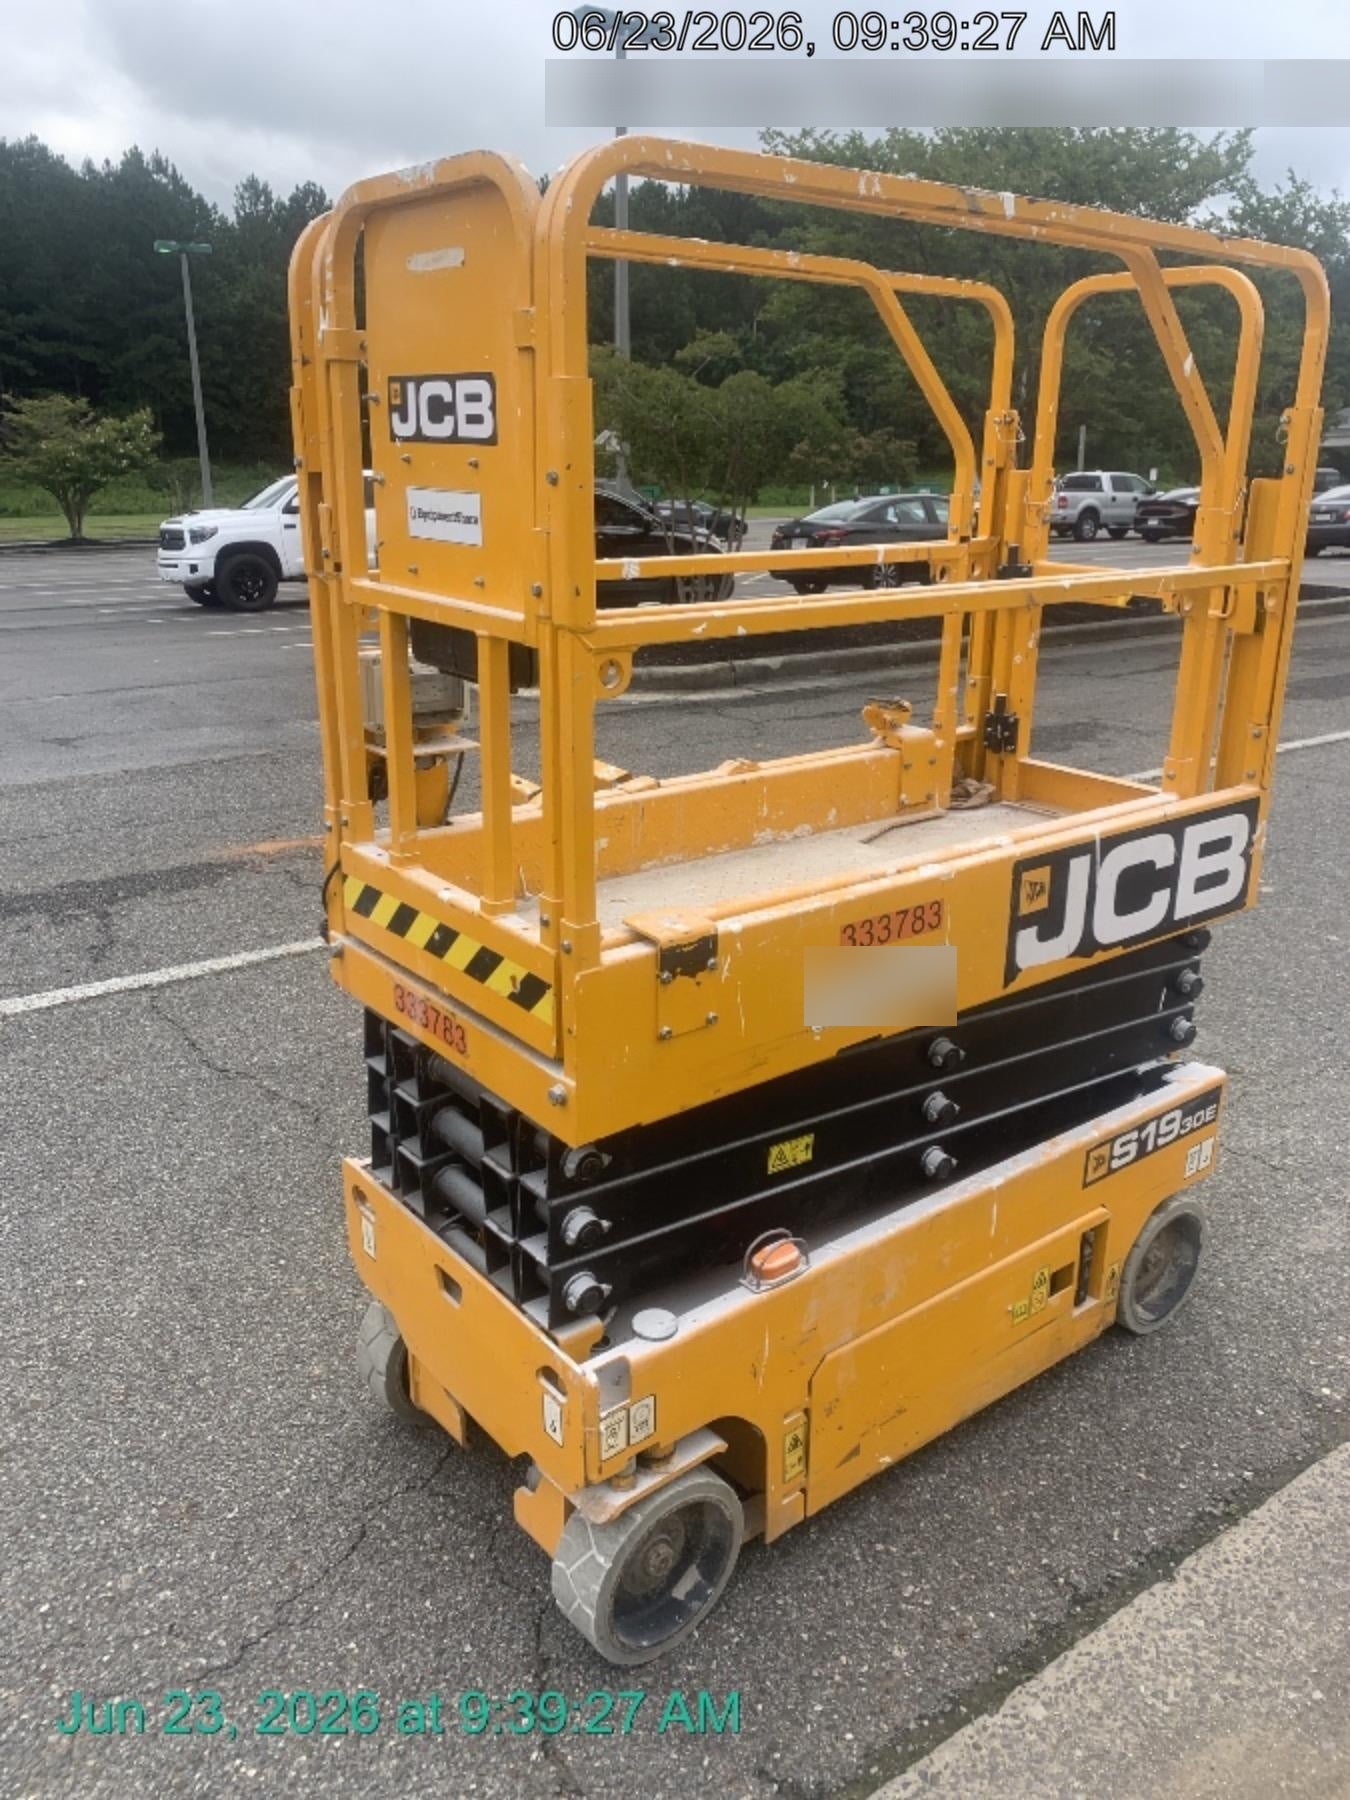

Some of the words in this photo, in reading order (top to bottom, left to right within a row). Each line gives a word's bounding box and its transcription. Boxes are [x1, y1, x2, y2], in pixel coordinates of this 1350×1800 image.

[391, 379, 495, 439] JCB
[842, 900, 942, 947] 333783
[1016, 813, 1250, 970] JCB
[394, 983, 467, 1055] 333783
